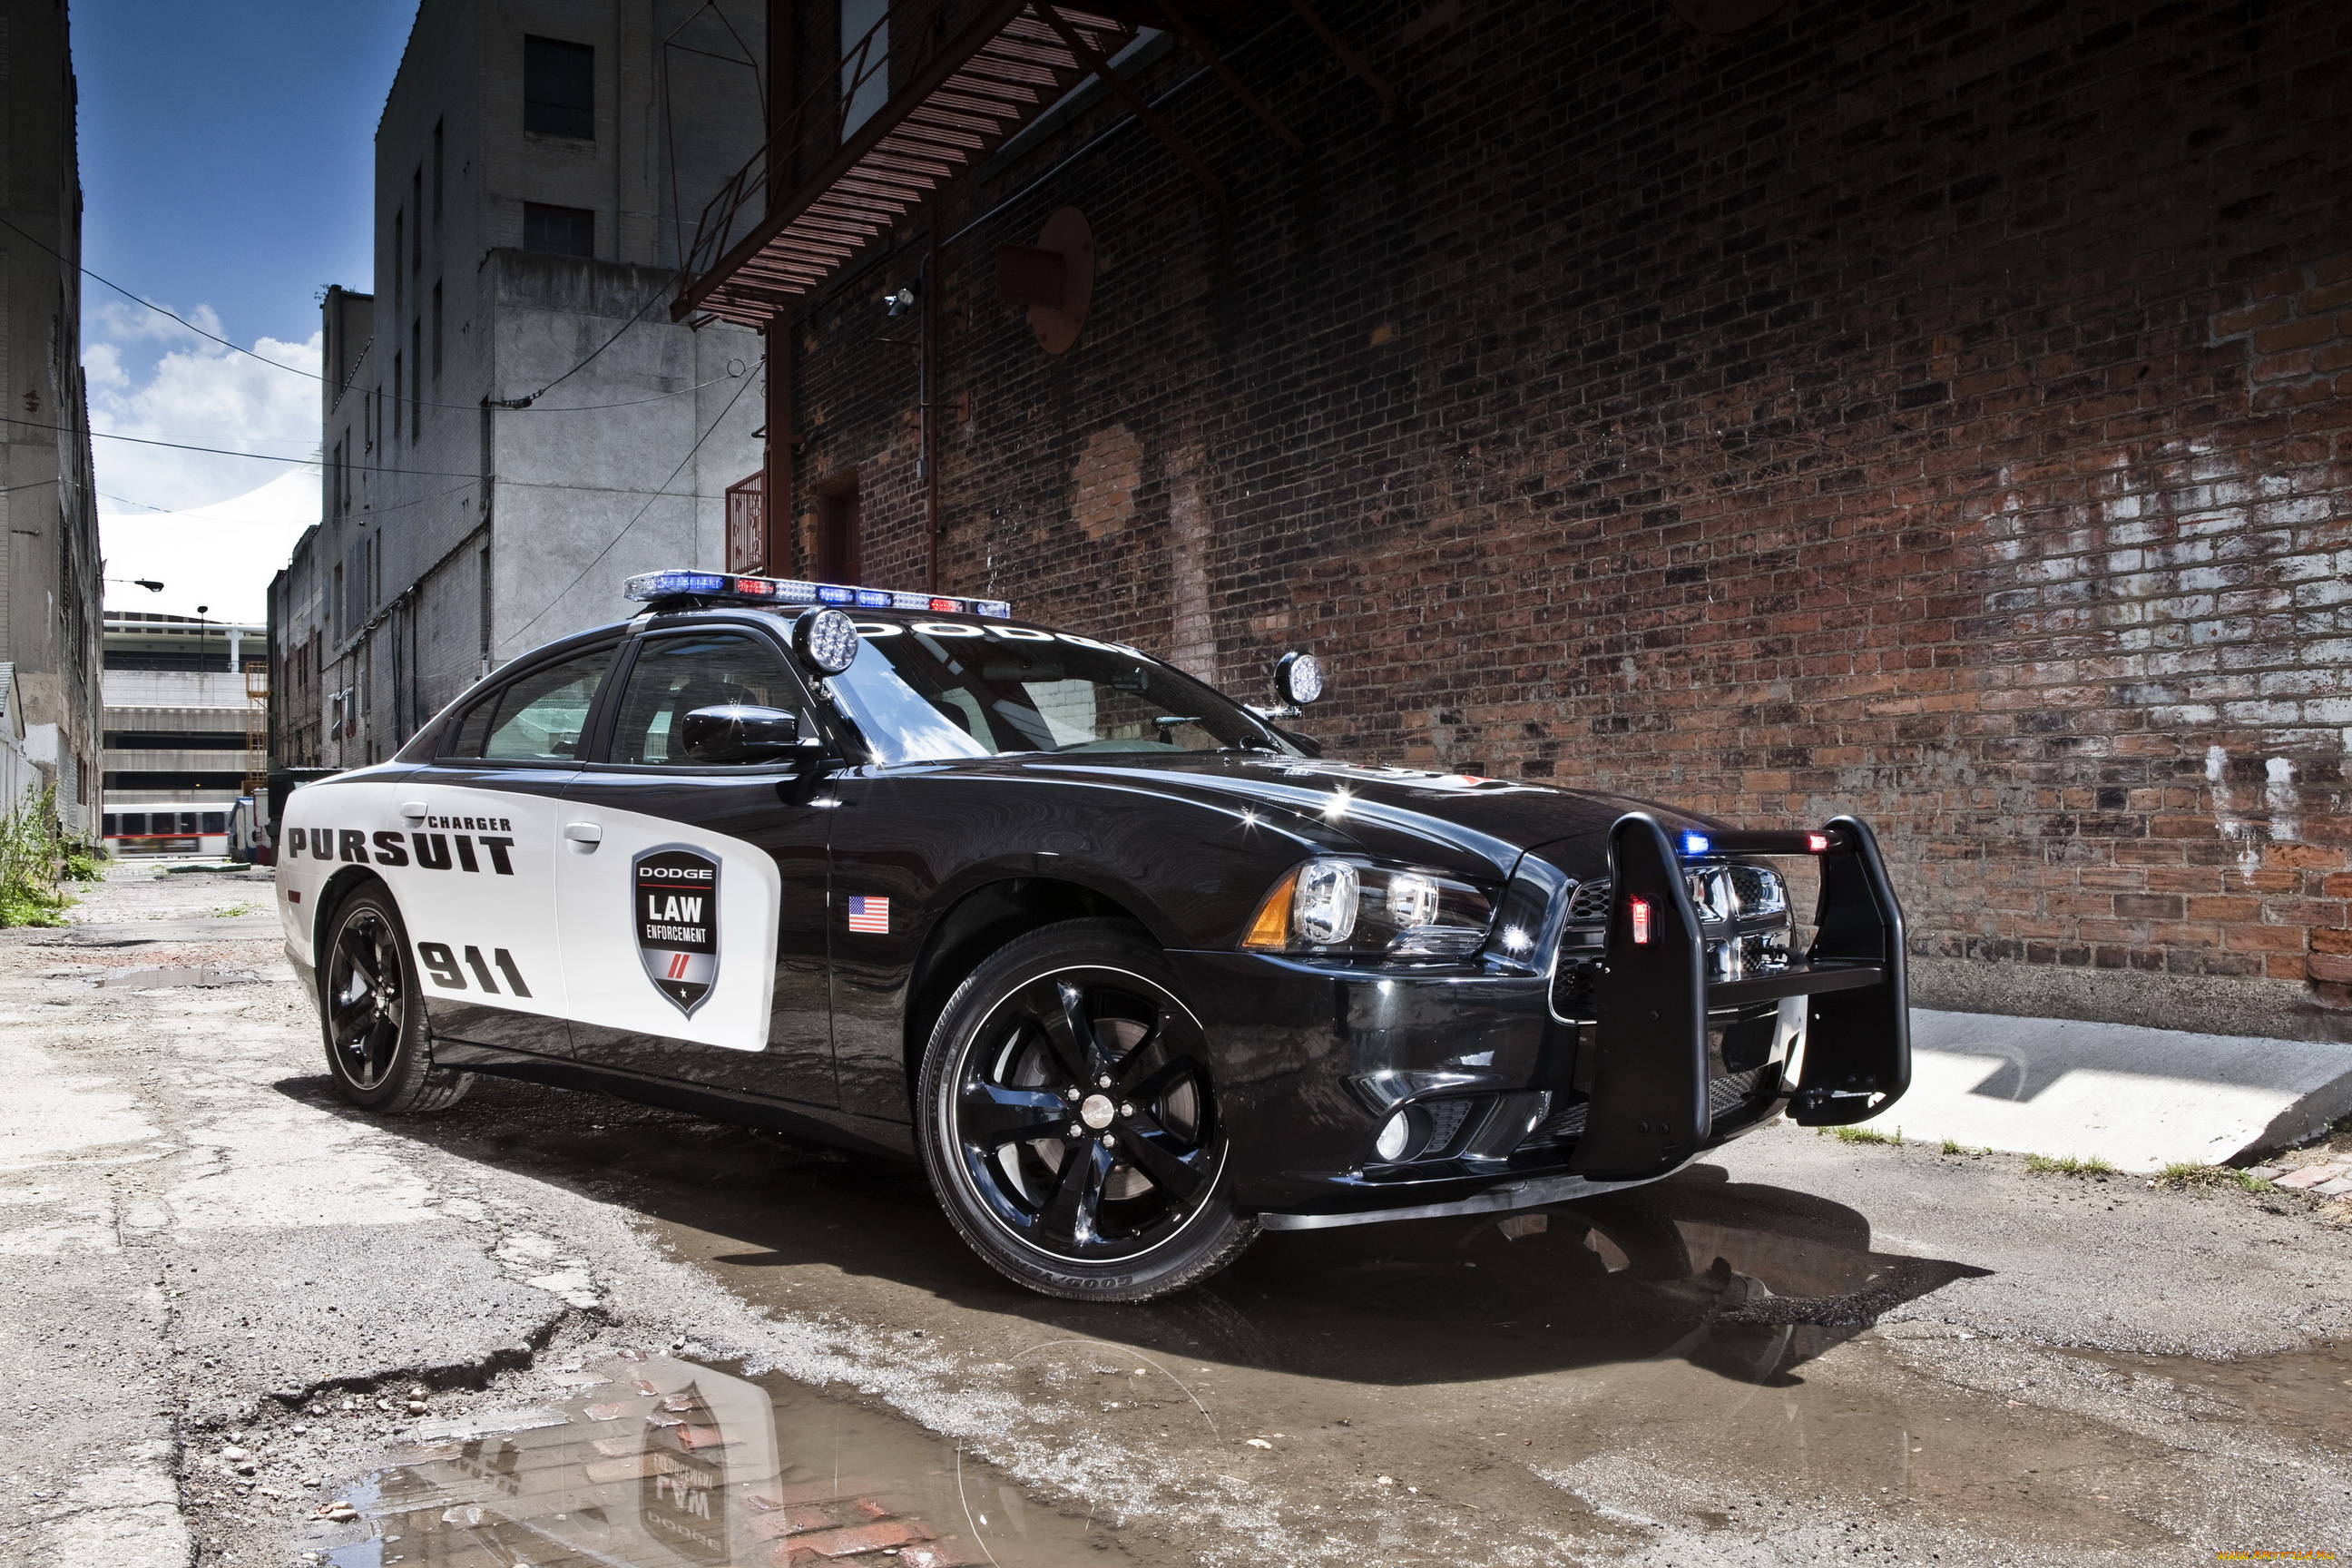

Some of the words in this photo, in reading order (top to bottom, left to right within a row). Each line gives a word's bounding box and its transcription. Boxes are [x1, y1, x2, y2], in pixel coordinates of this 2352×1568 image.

[428, 816, 512, 832] CHARGER
[288, 827, 514, 876] PURSUIT
[639, 867, 713, 879] DODGE
[648, 894, 702, 923] LAW
[646, 924, 706, 944] ENFORCEMENT
[416, 941, 534, 999] 911
